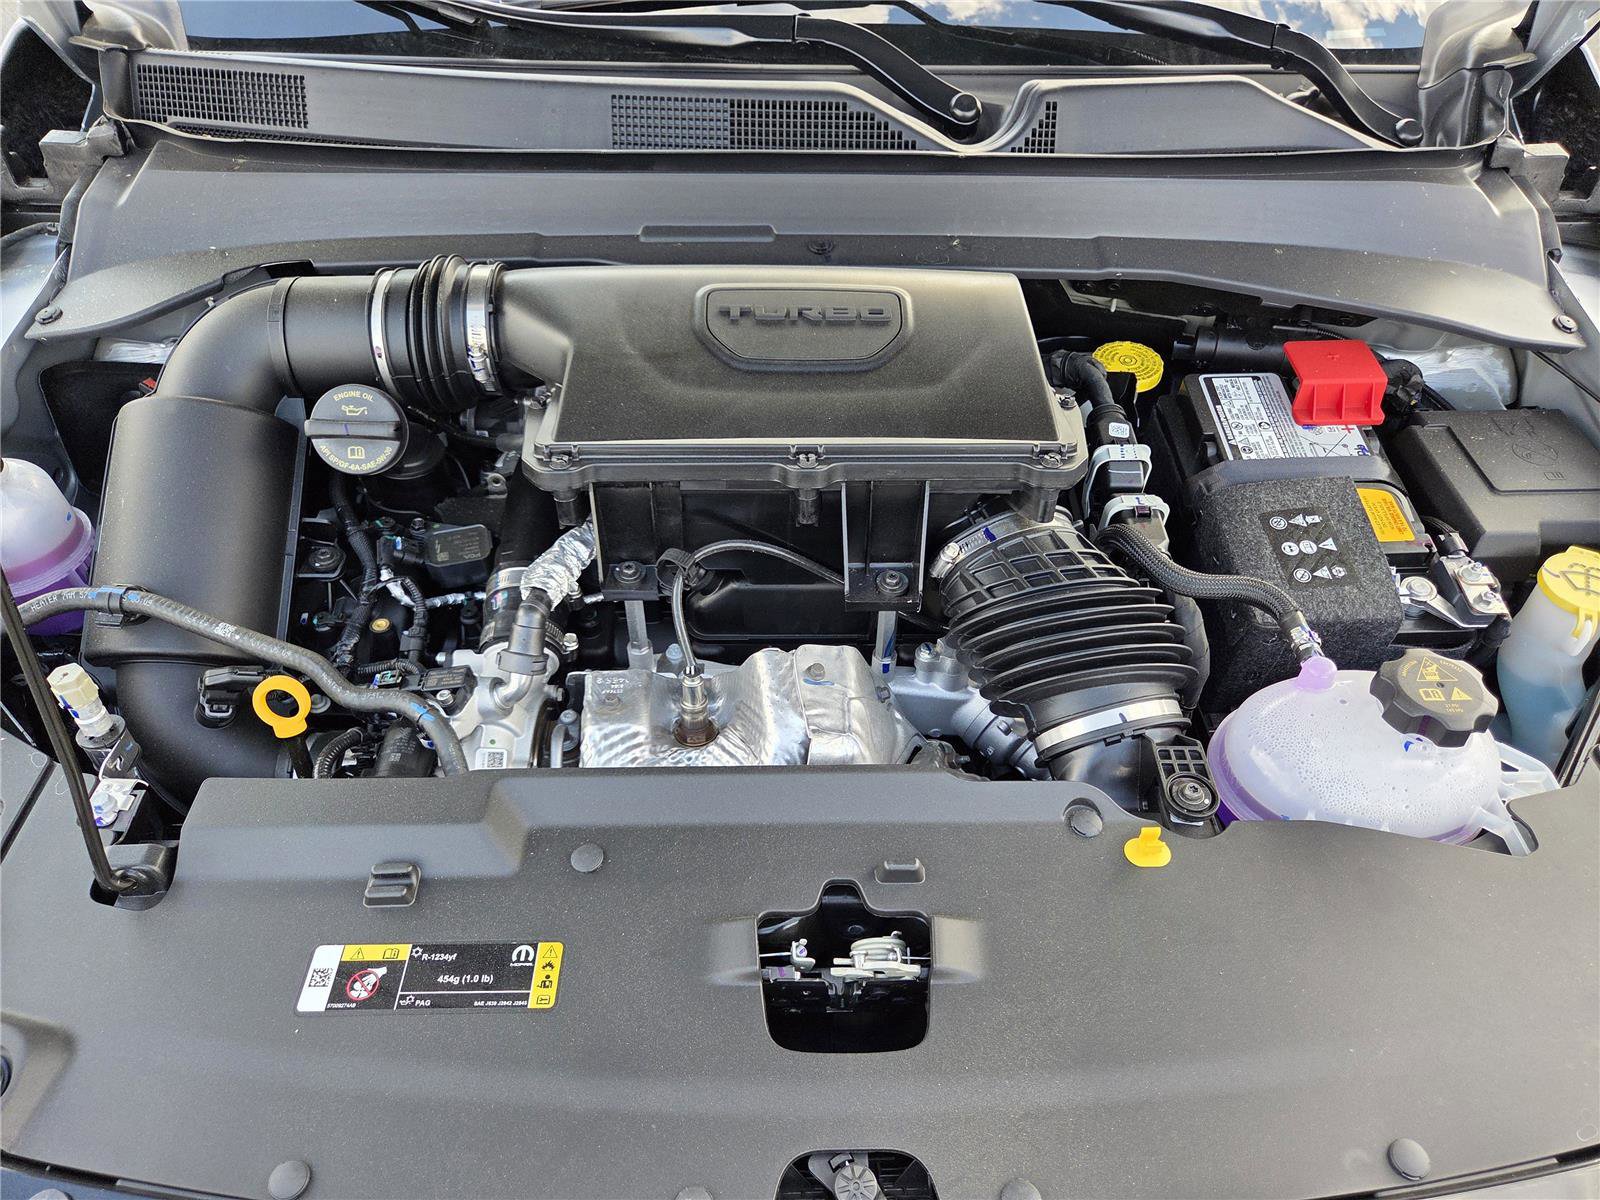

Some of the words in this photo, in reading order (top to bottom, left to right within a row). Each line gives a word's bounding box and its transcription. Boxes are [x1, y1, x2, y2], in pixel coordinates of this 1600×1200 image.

[719, 306, 892, 322] TURBO
[333, 390, 361, 402] ENGINE
[362, 393, 374, 402] OIL
[31, 595, 58, 612] HEATER
[421, 953, 457, 962] R-1234yf
[437, 974, 460, 985] 454g
[461, 974, 479, 985] (1.0
[481, 974, 494, 984] lb)
